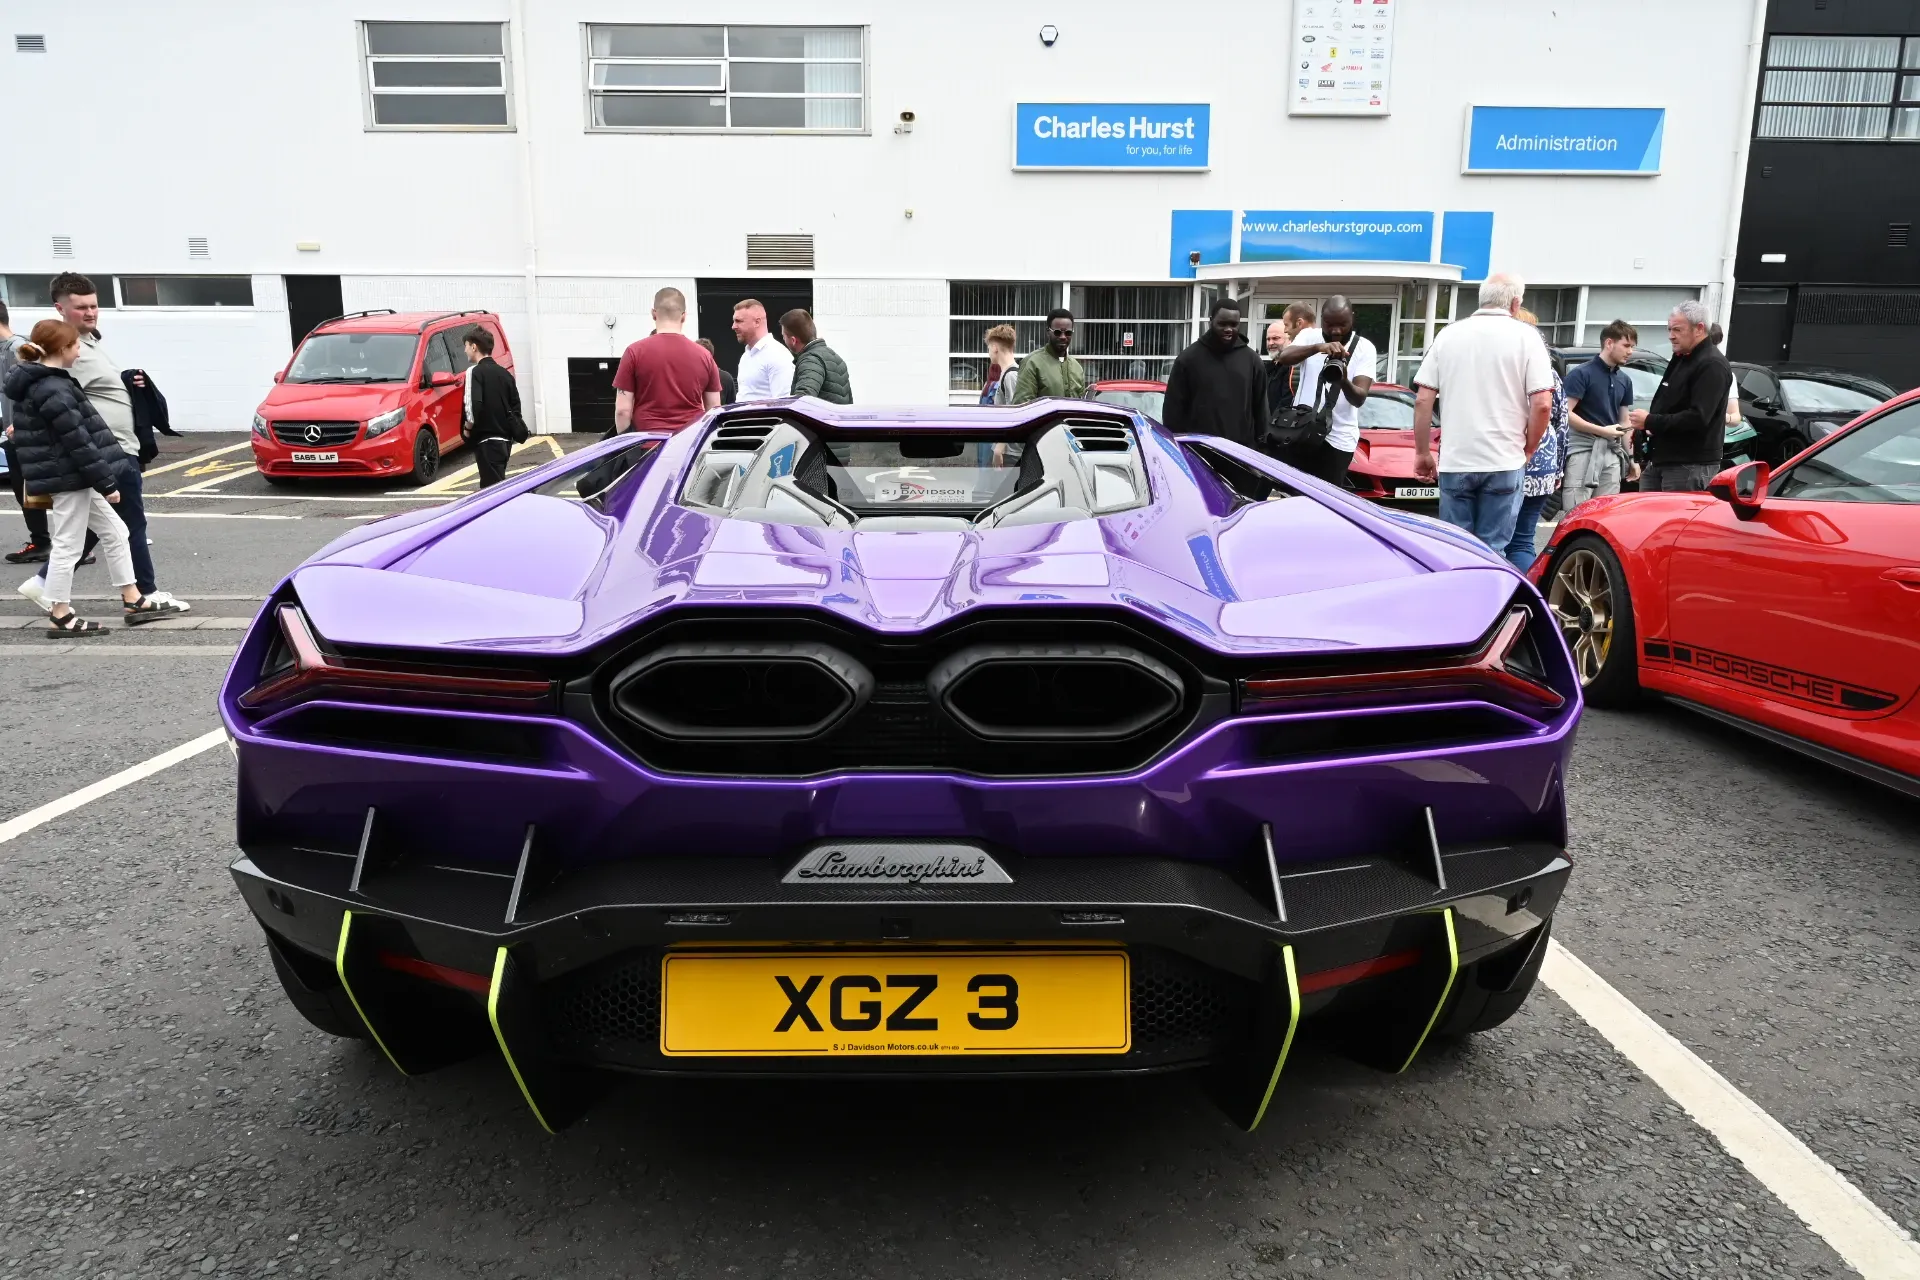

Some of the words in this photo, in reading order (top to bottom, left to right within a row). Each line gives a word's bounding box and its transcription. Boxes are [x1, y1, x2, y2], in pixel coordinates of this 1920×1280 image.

[1034, 116, 1126, 139] Charles
[1129, 117, 1195, 139] Hurst
[1126, 145, 1139, 155] for
[1141, 146, 1162, 158] you,
[1163, 145, 1177, 155] for
[1178, 144, 1193, 155] life
[1496, 134, 1618, 151] Administration
[1241, 219, 1423, 236] www.charleshurstgroup.com
[1696, 652, 1834, 701] PORSCHE
[798, 851, 986, 882] Lamborghini
[774, 974, 938, 1032] XGZ
[967, 974, 1019, 1031] 3
[832, 1043, 839, 1051] S
[840, 1043, 846, 1051] J
[847, 1043, 885, 1051] Davidson
[887, 1043, 939, 1051] Motors.co.uk
